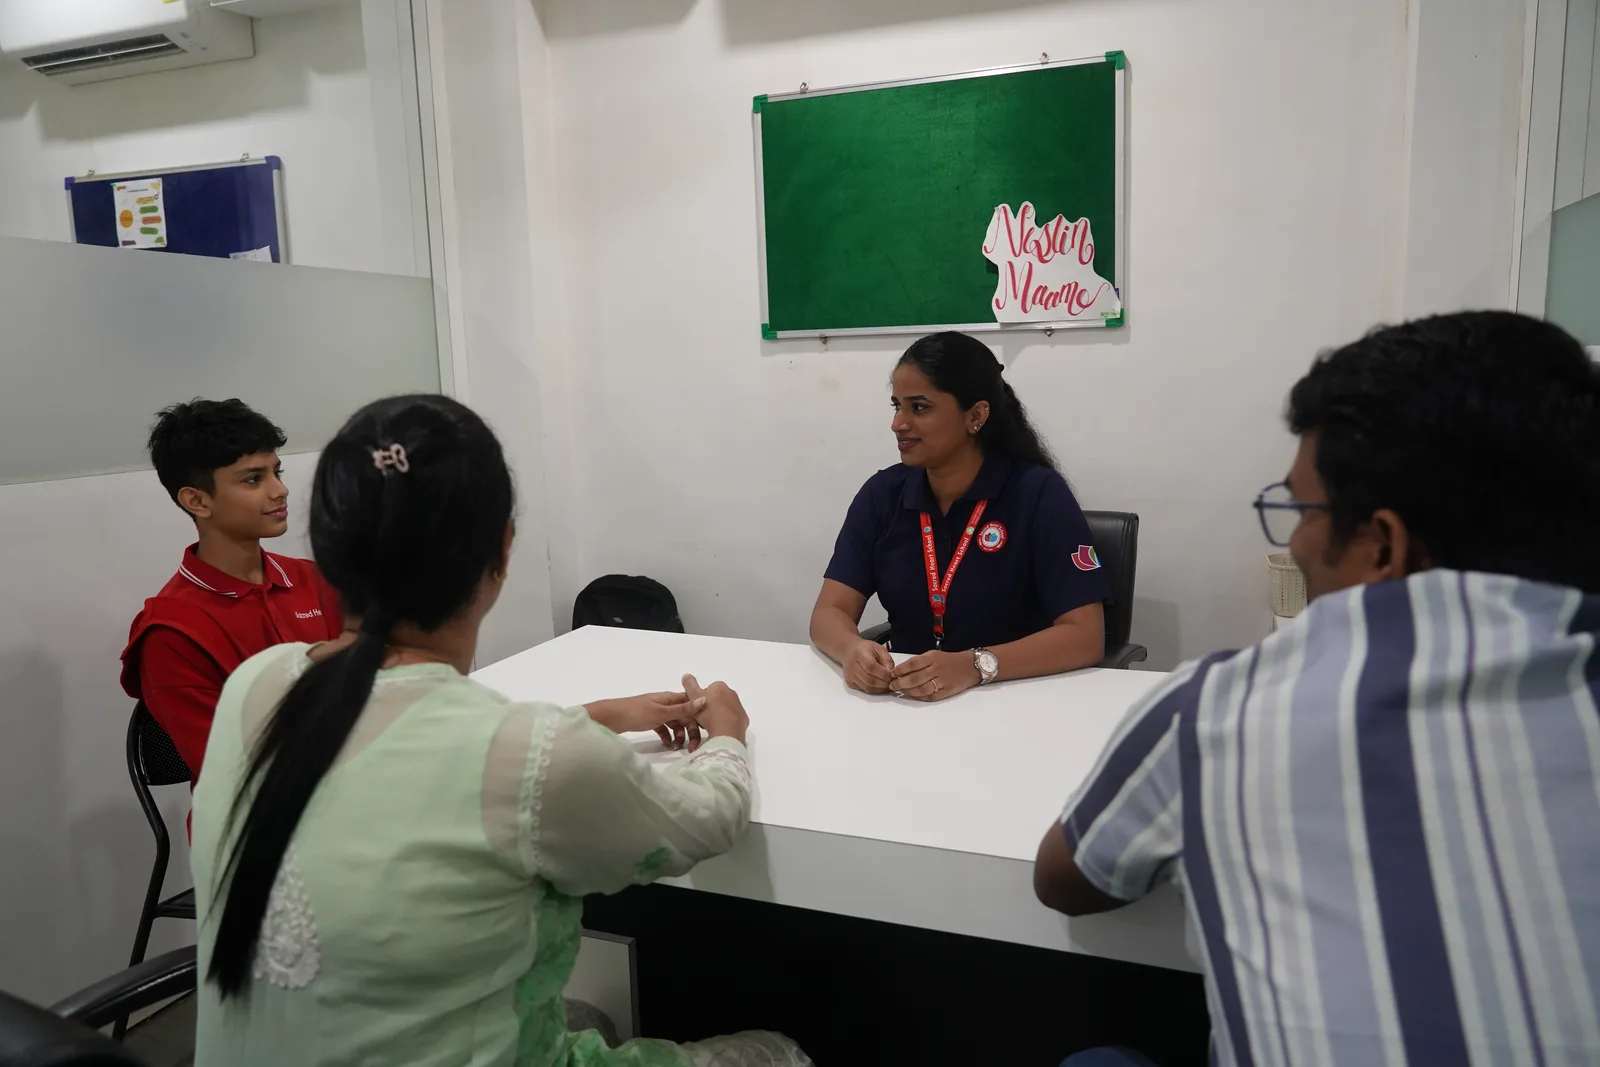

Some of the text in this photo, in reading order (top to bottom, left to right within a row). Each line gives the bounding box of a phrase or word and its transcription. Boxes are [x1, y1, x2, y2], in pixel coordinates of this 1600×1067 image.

[983, 205, 1095, 266] Neslin
[925, 535, 933, 552] School
[942, 537, 969, 592] Sacred Heart School
